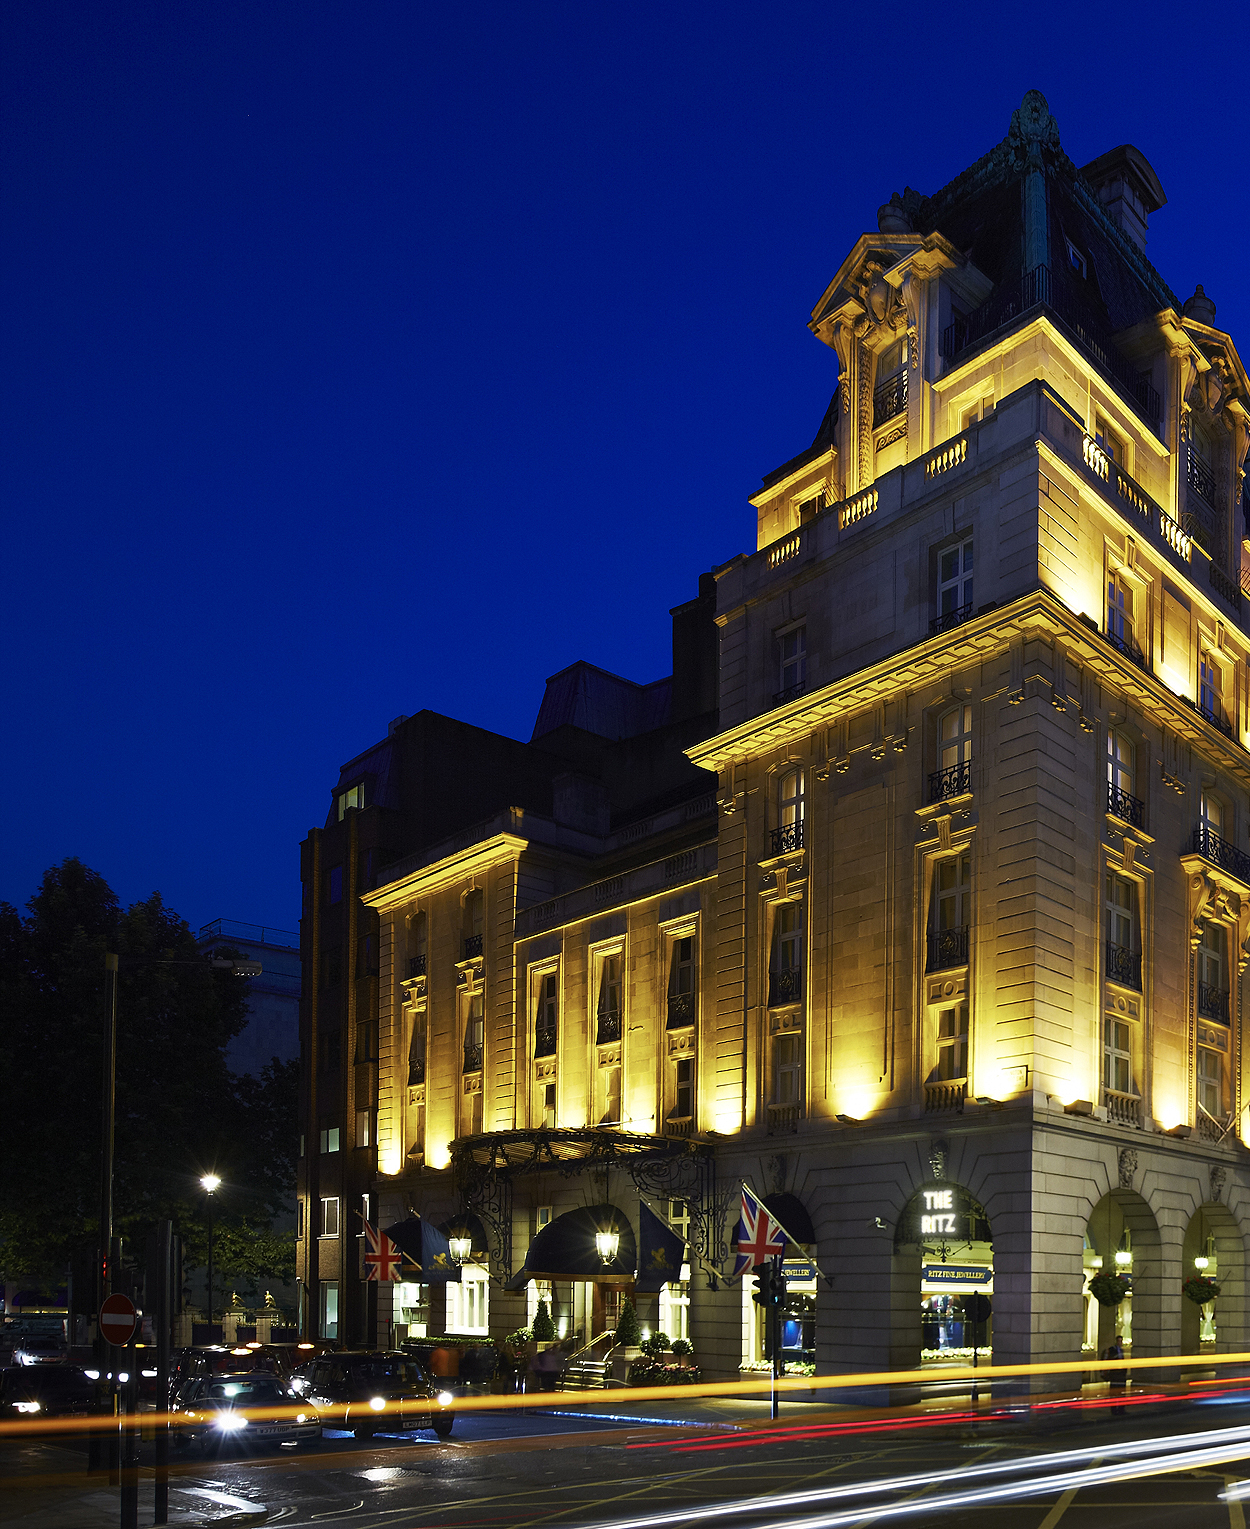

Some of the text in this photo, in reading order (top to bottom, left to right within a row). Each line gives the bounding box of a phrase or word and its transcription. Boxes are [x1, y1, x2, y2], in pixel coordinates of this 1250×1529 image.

[923, 1190, 953, 1210] THE
[921, 1214, 956, 1233] RITZ
[928, 1270, 986, 1279] RITZ FINE JEWELLERY
